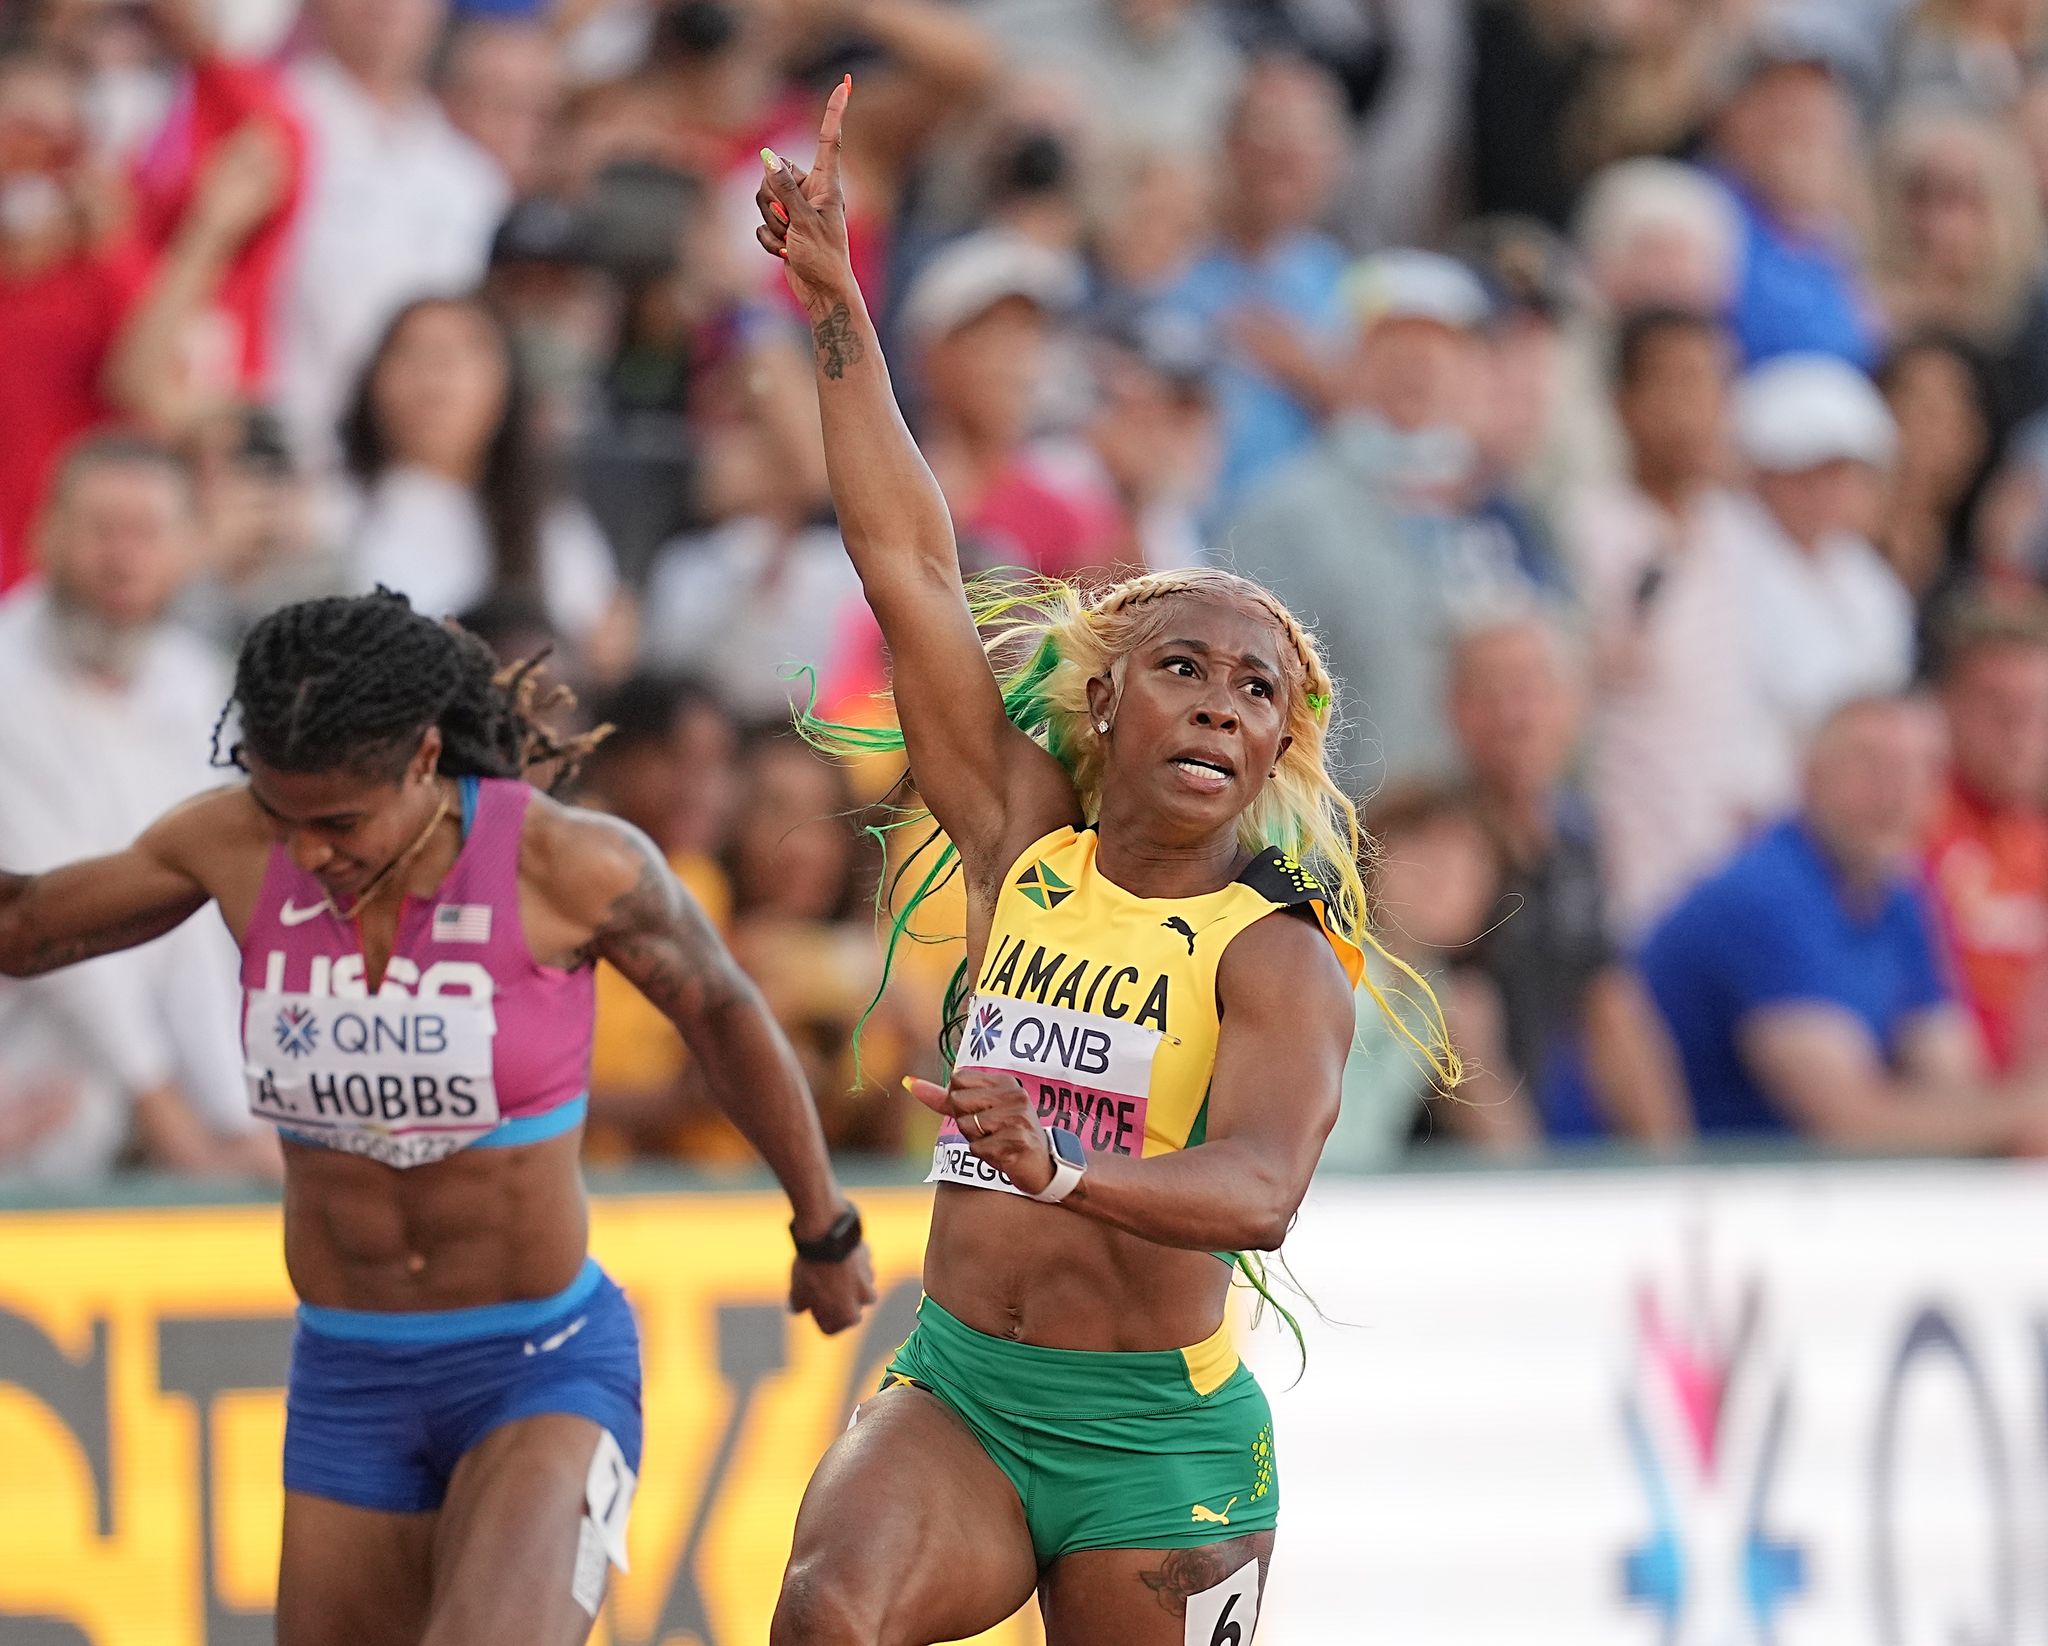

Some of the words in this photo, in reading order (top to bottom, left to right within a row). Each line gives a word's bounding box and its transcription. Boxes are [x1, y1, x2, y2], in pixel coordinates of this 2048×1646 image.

[980, 934, 1169, 1033] JAMAICA
[333, 1013, 447, 1055] QNB
[1009, 1016, 1112, 1075] QNB
[310, 1072, 477, 1121] HOBBS
[1209, 1592, 1243, 1646] 6
